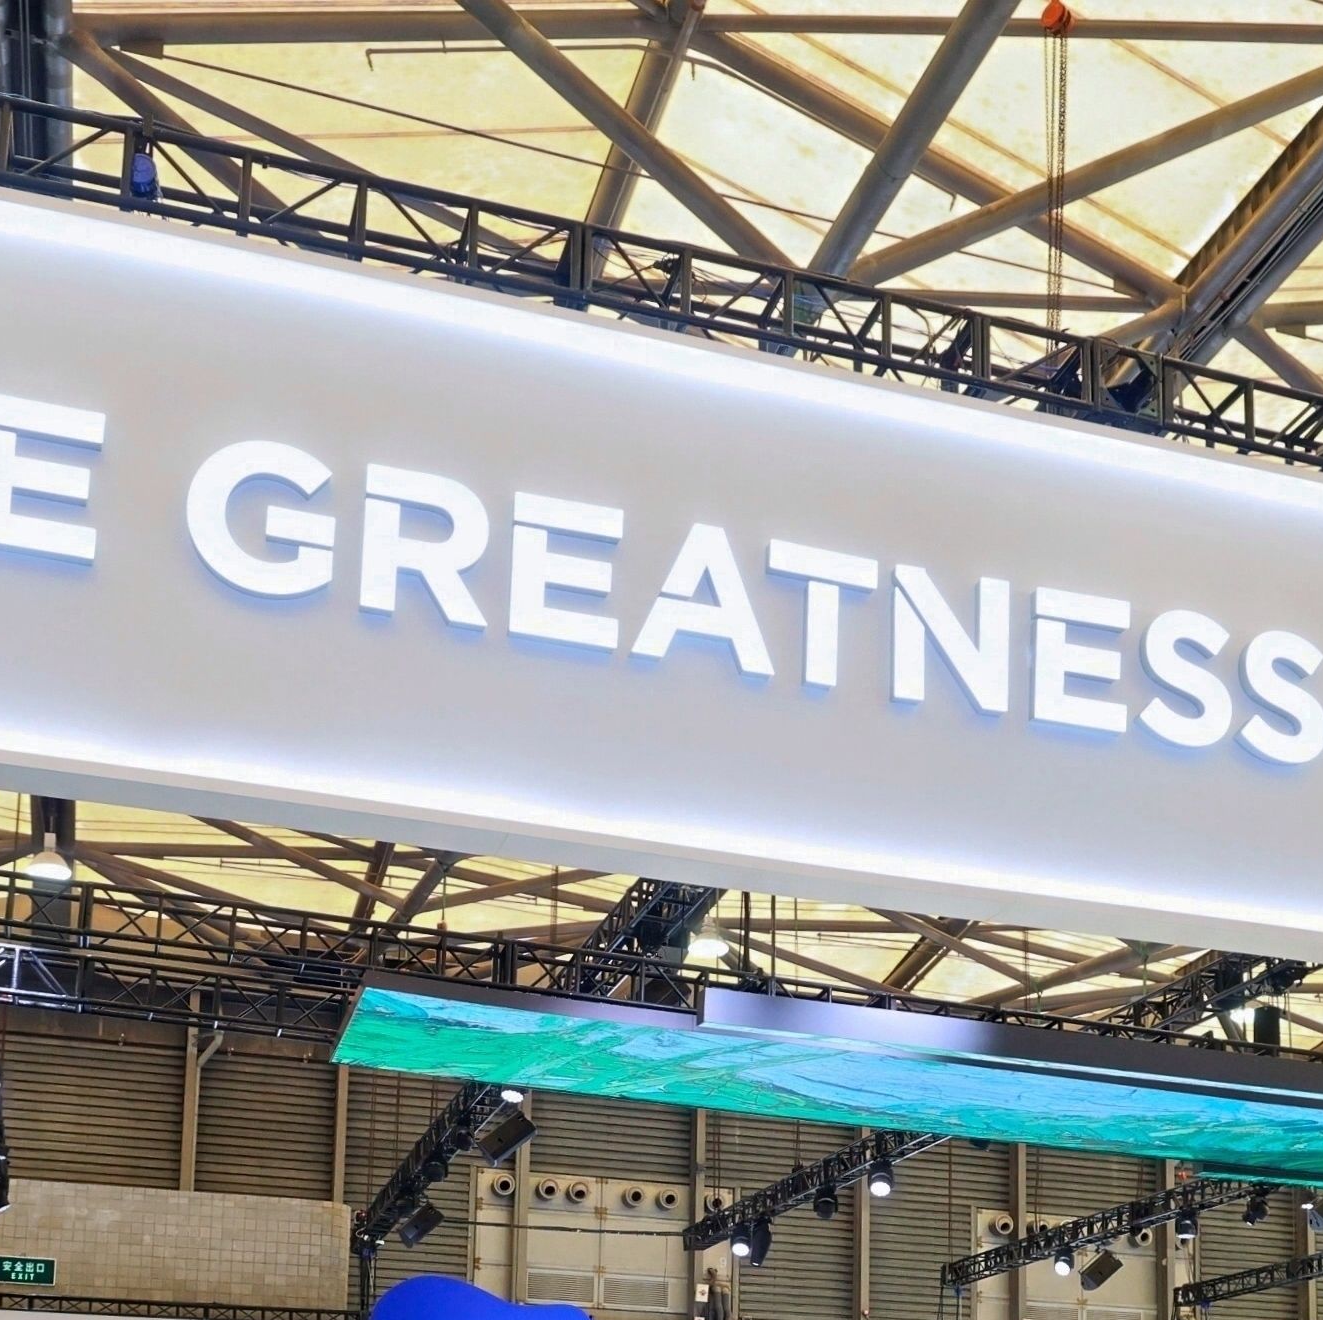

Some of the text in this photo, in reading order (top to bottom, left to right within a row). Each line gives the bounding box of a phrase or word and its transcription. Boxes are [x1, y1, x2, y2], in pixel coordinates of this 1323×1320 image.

[2, 1260, 45, 1273] 安全出口
[11, 1272, 35, 1280] EXIT
